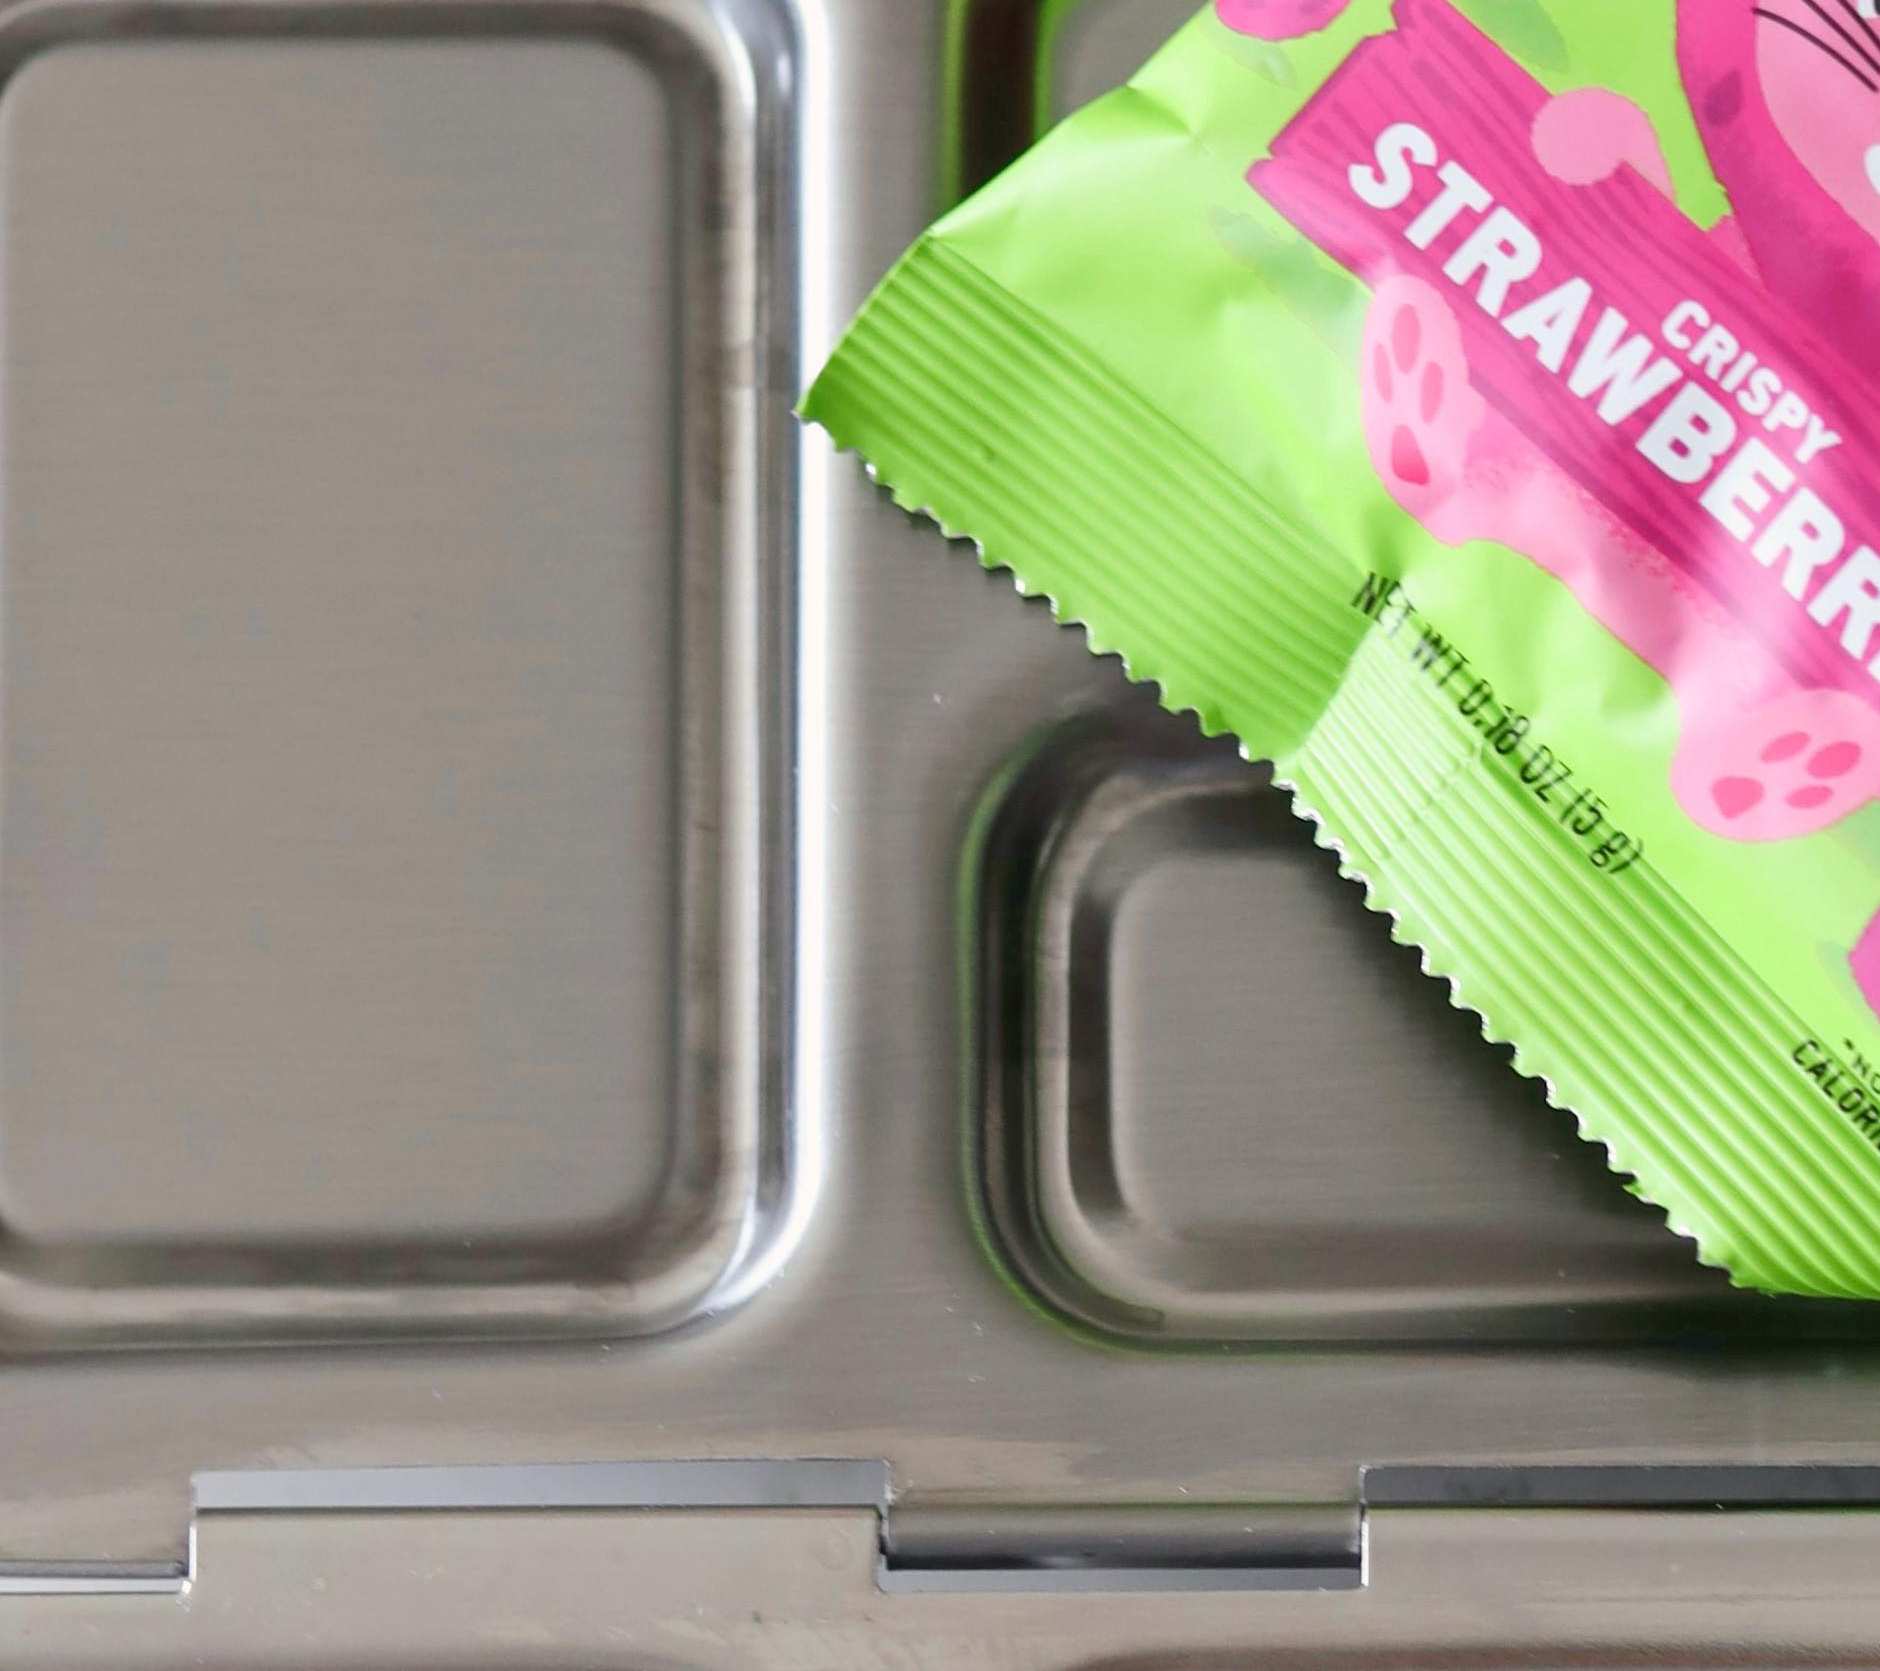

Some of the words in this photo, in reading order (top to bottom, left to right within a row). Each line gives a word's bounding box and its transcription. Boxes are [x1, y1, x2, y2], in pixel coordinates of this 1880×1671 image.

[1661, 300, 1842, 464] CRISPY
[1350, 572, 1416, 638] NET
[1519, 744, 1573, 803] OZ
